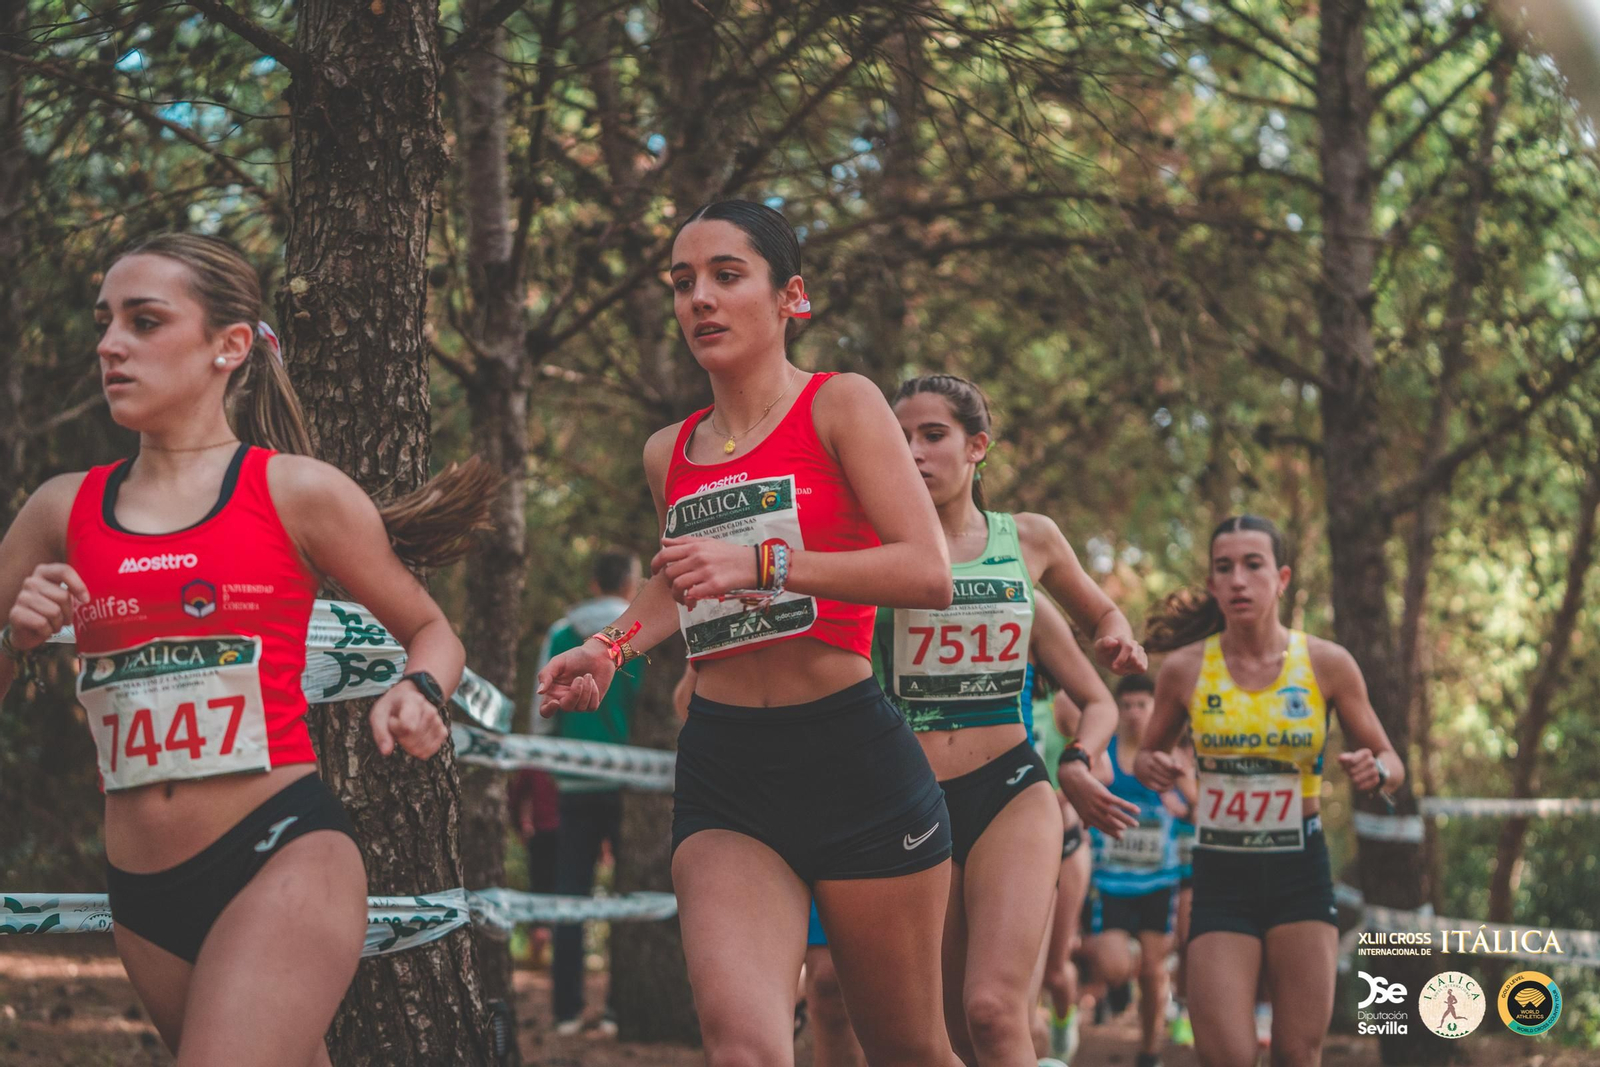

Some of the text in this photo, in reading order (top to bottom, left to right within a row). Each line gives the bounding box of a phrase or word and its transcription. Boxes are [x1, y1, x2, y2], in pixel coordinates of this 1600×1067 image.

[681, 491, 750, 522] ITÁLICA
[222, 584, 274, 594] UNIVERSIDAD
[952, 580, 997, 596] ÁLICA
[908, 622, 1022, 665] 7512
[103, 695, 246, 773] 7447
[1201, 732, 1262, 748] OLIMPO
[1207, 789, 1294, 824] 7477
